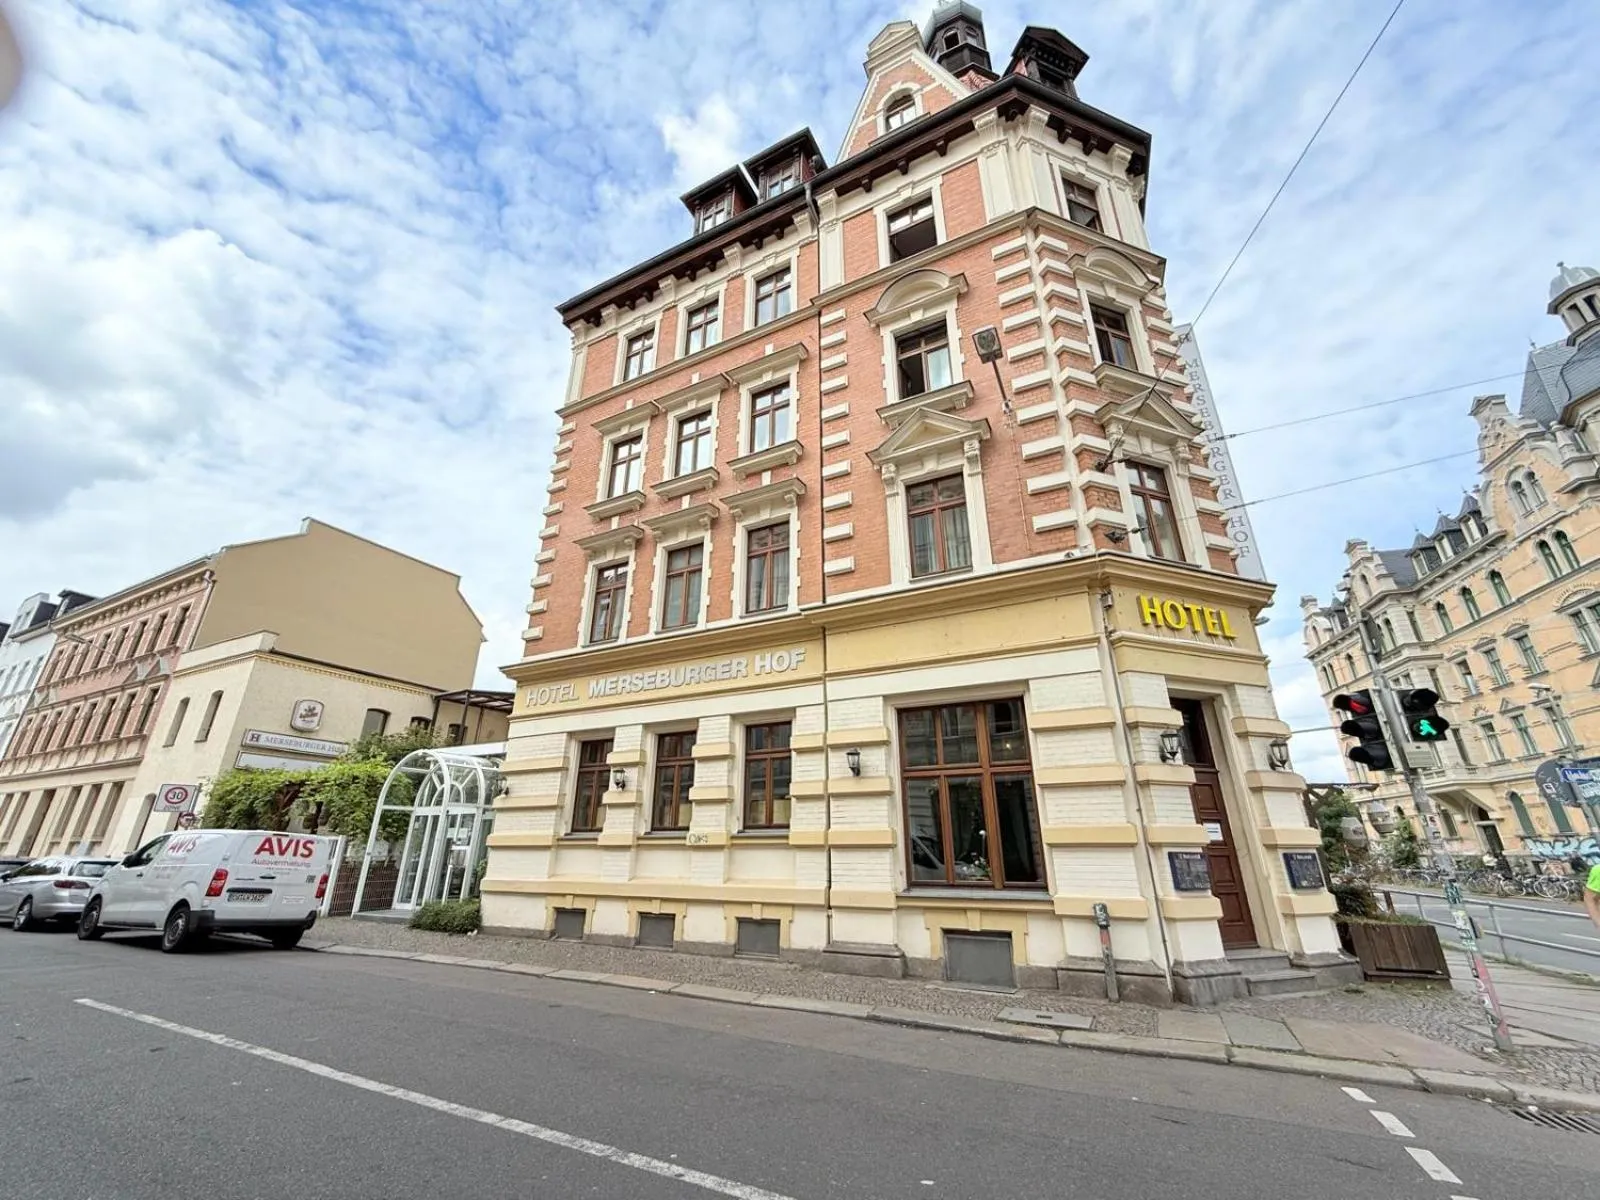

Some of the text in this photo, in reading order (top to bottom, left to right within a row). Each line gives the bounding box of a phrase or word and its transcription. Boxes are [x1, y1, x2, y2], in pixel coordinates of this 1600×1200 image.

[1230, 516, 1250, 558] HOF
[1137, 595, 1238, 640] HOTEL
[525, 648, 806, 707] HOTEL MERSEBURGER HOF
[169, 791, 183, 800] 30
[167, 836, 199, 854] AVIS
[255, 837, 315, 858] AVIS
[251, 858, 312, 868] Autovermietung
